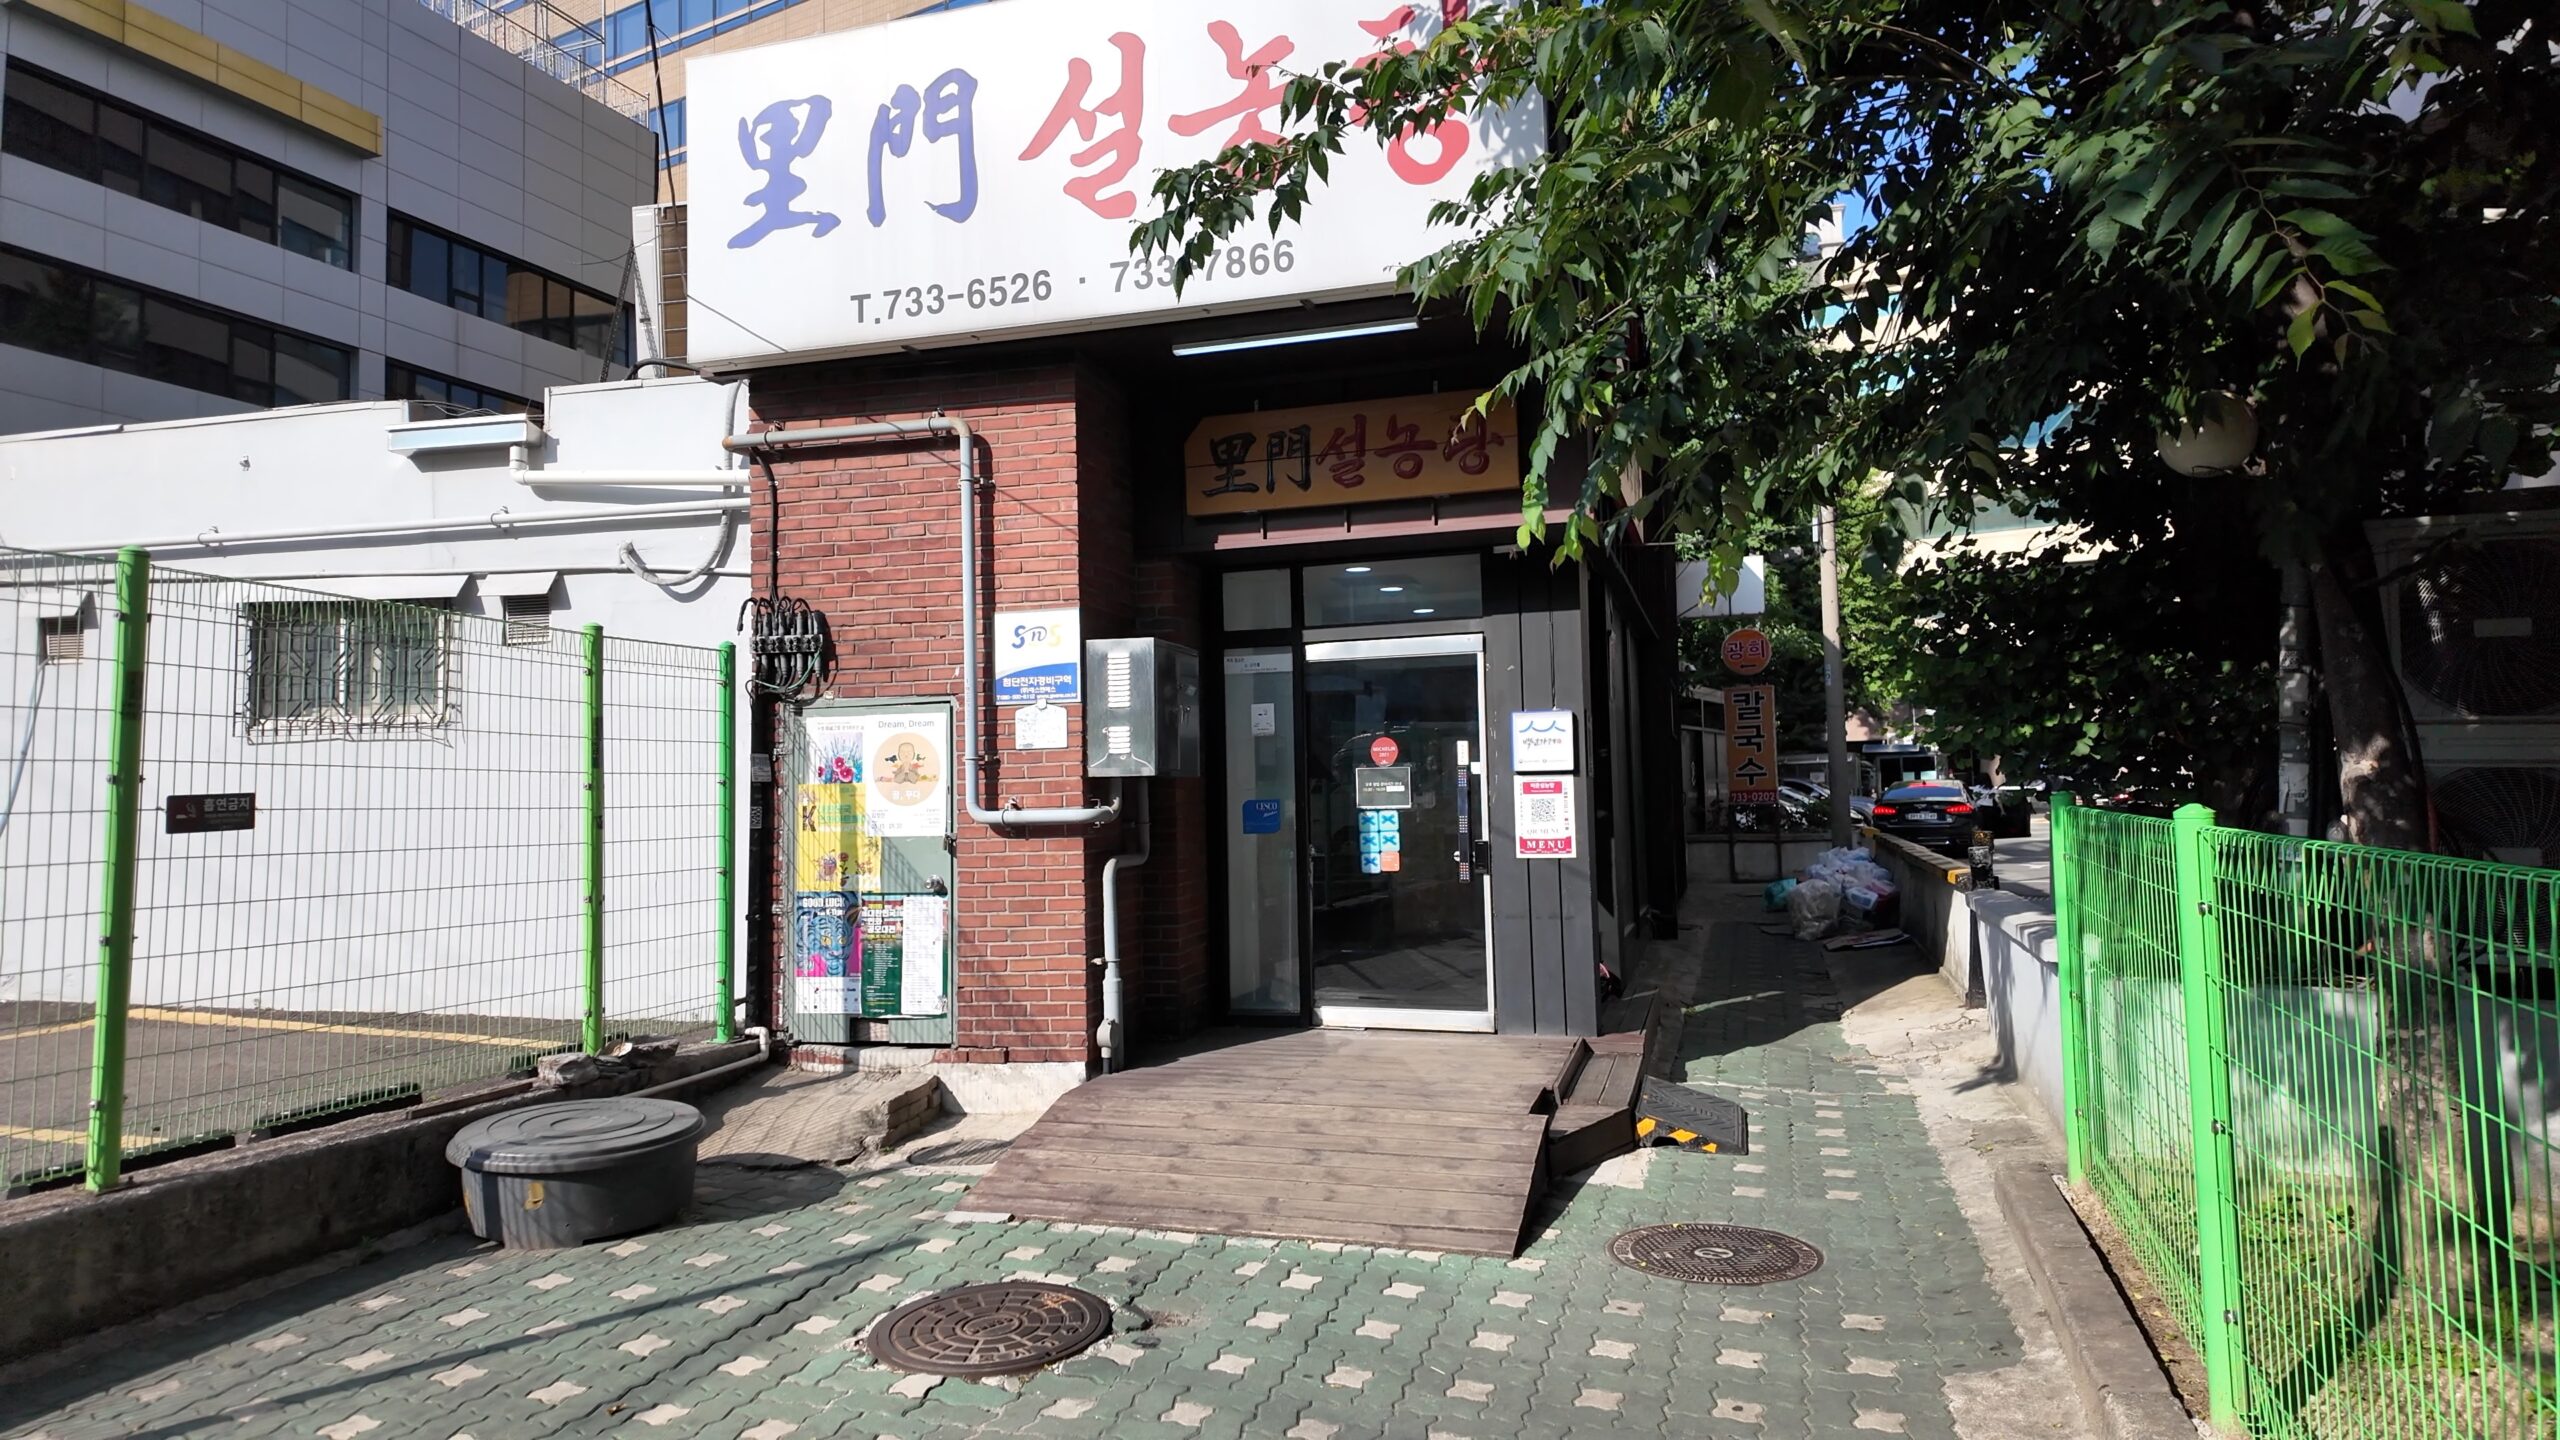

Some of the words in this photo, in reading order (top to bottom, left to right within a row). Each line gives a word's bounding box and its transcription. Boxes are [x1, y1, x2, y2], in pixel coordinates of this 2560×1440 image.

[727, 68, 978, 249] 里門
[850, 269, 1053, 325] T.733-6526
[1726, 639, 1765, 660] 광희
[1002, 674, 1072, 688] 첨단전자경비구역
[878, 719, 904, 729] Dream,
[908, 719, 935, 727] Dream
[1732, 690, 1768, 786] 칼국수
[1731, 791, 1777, 802] 733-0202
[203, 797, 250, 812] 흡연금지
[1526, 840, 1565, 849] MENU
